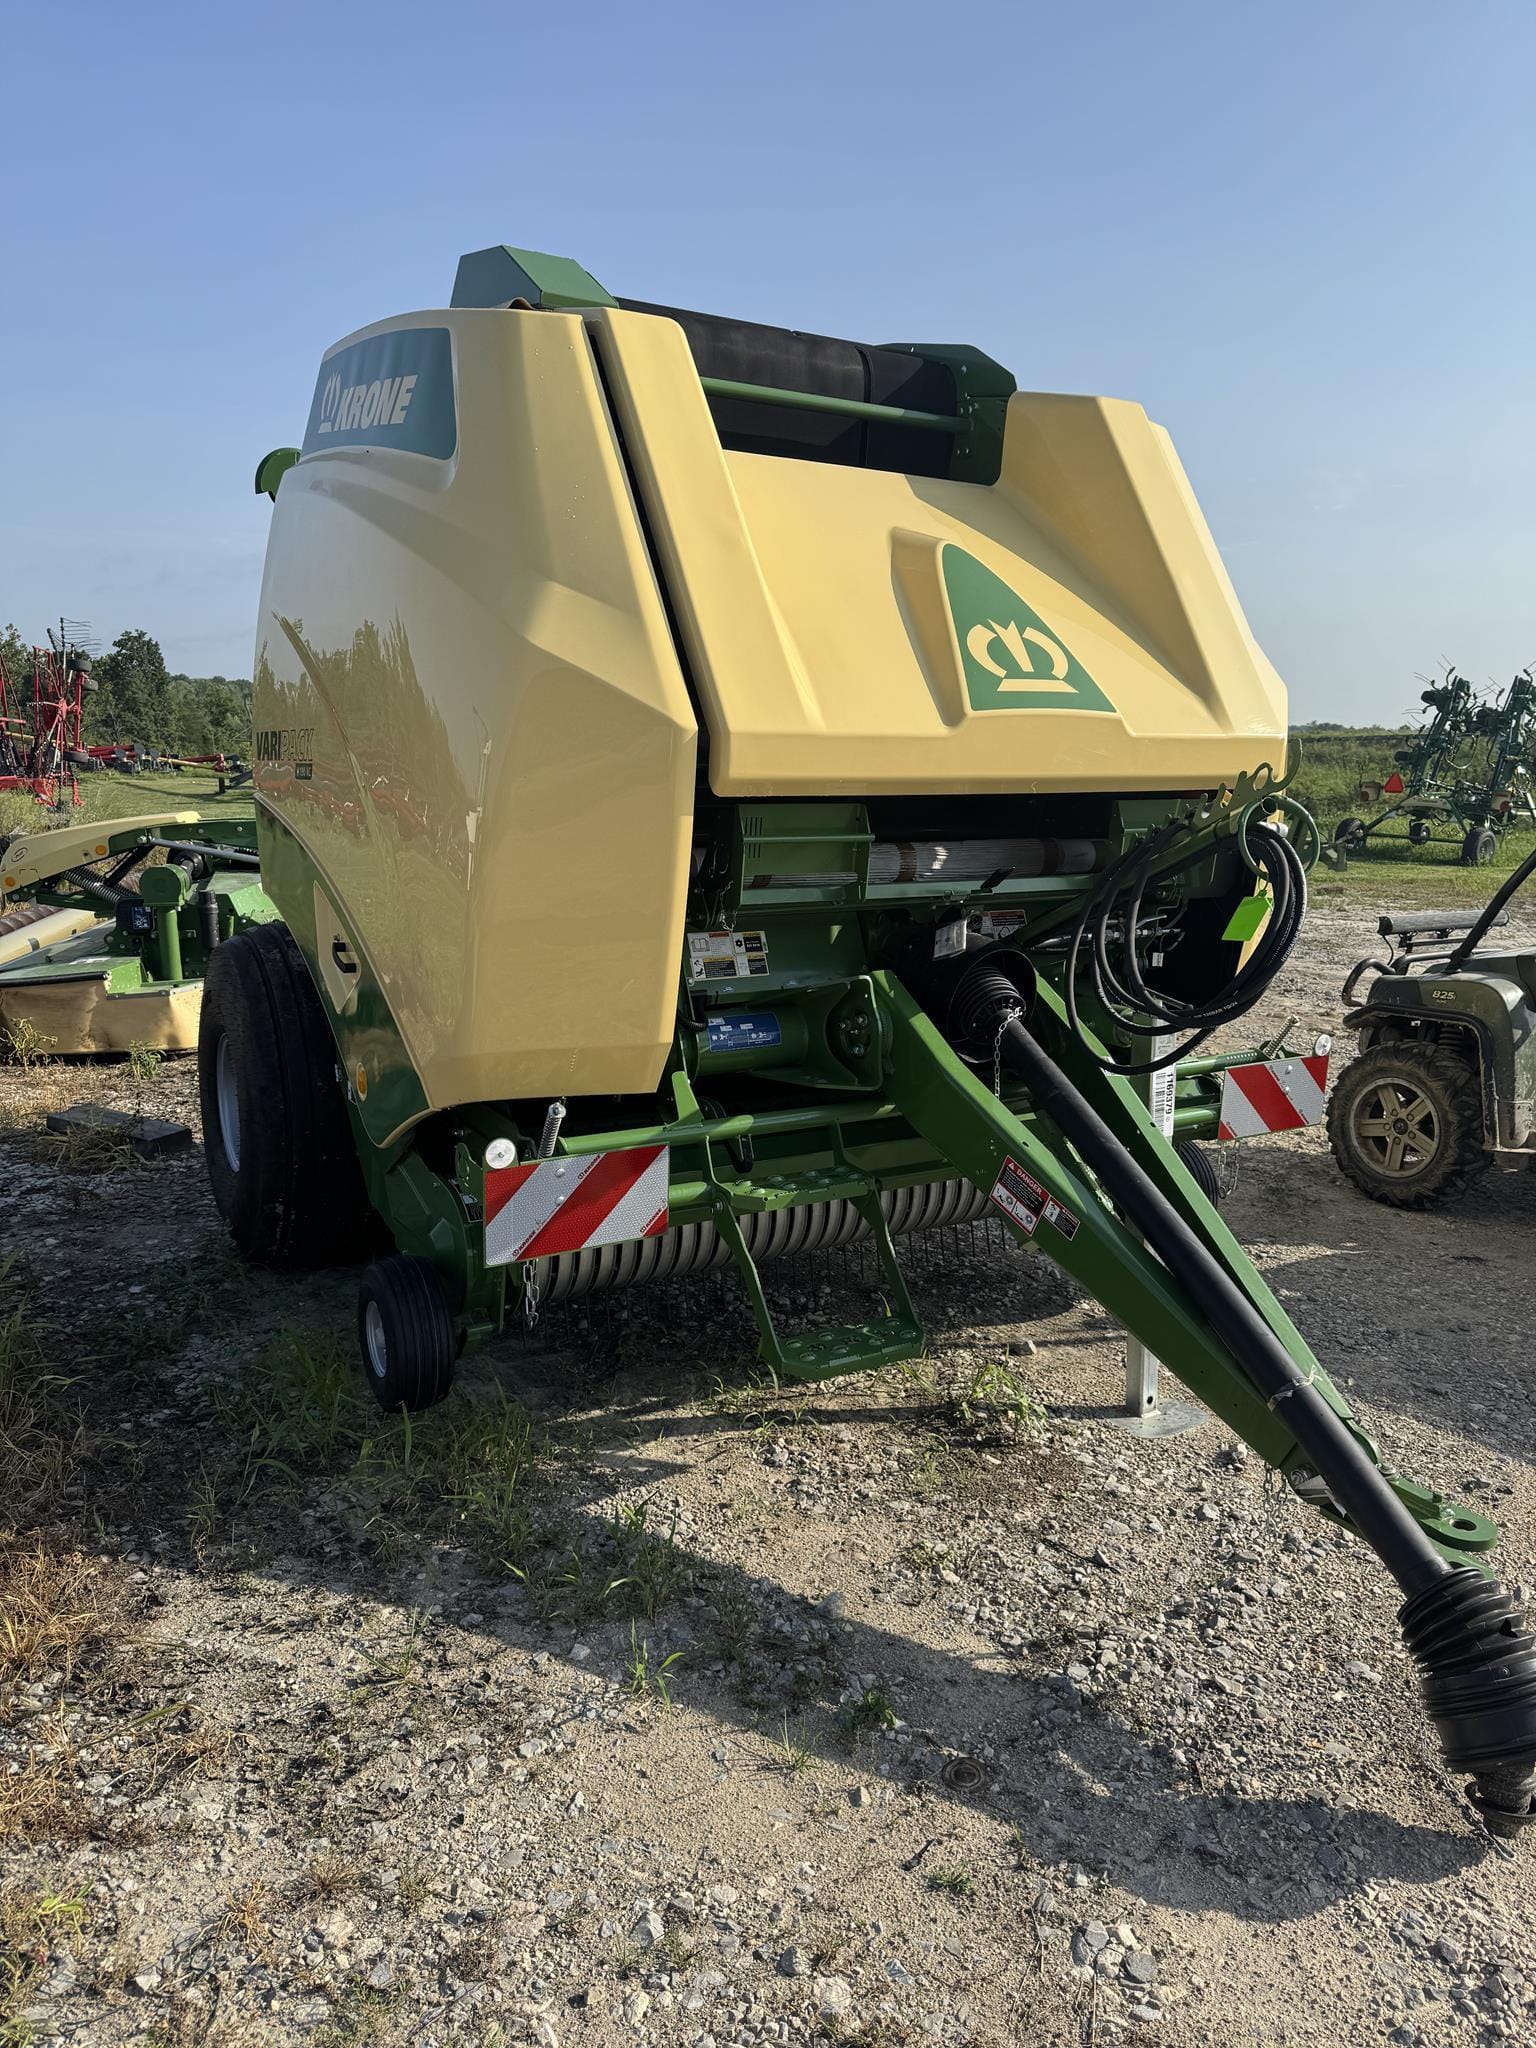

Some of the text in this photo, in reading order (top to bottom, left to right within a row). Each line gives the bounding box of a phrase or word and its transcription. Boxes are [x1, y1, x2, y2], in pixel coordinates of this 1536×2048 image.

[333, 374, 419, 432] KRONE
[1166, 1072, 1174, 1115] 1169379
[1016, 1168, 1043, 1195] DANGER
